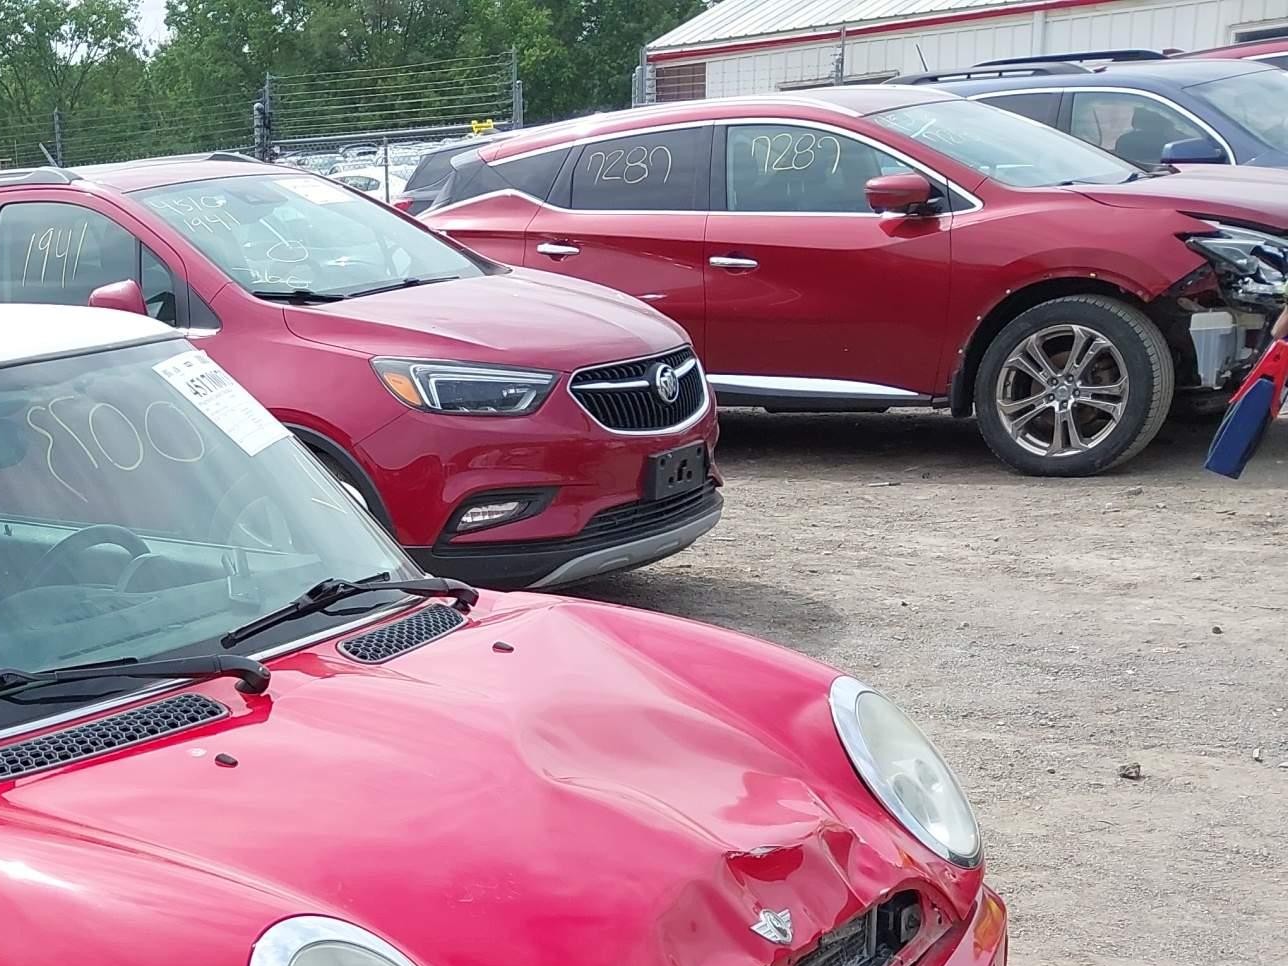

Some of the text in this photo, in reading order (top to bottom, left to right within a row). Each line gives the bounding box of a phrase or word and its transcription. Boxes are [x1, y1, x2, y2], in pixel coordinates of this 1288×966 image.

[587, 145, 673, 185] 7287
[751, 132, 841, 175] 7287
[183, 211, 241, 233] 1941
[22, 222, 88, 288] 1941
